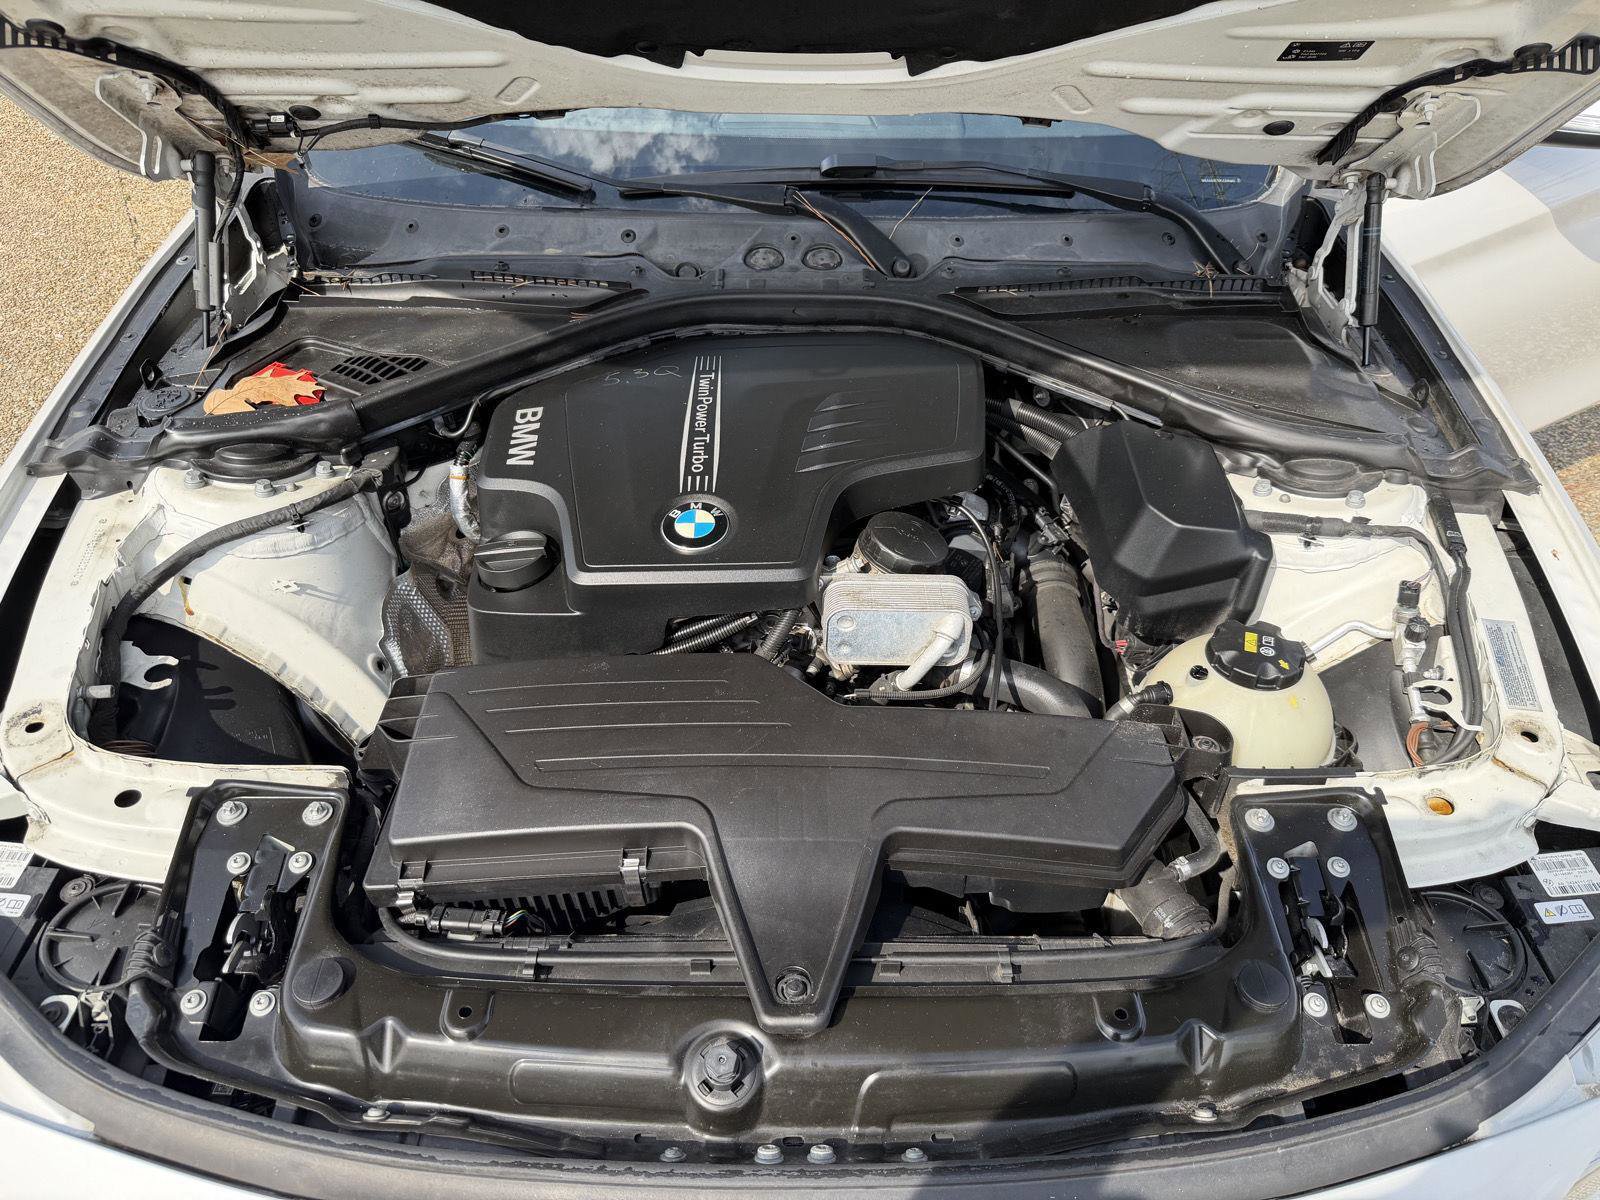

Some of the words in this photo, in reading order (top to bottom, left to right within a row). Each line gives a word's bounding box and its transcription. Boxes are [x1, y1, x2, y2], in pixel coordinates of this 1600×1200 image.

[695, 372, 715, 433] TwinPower
[506, 406, 544, 466] BMW
[691, 434, 710, 473] Turbo
[668, 502, 724, 519] BMW
